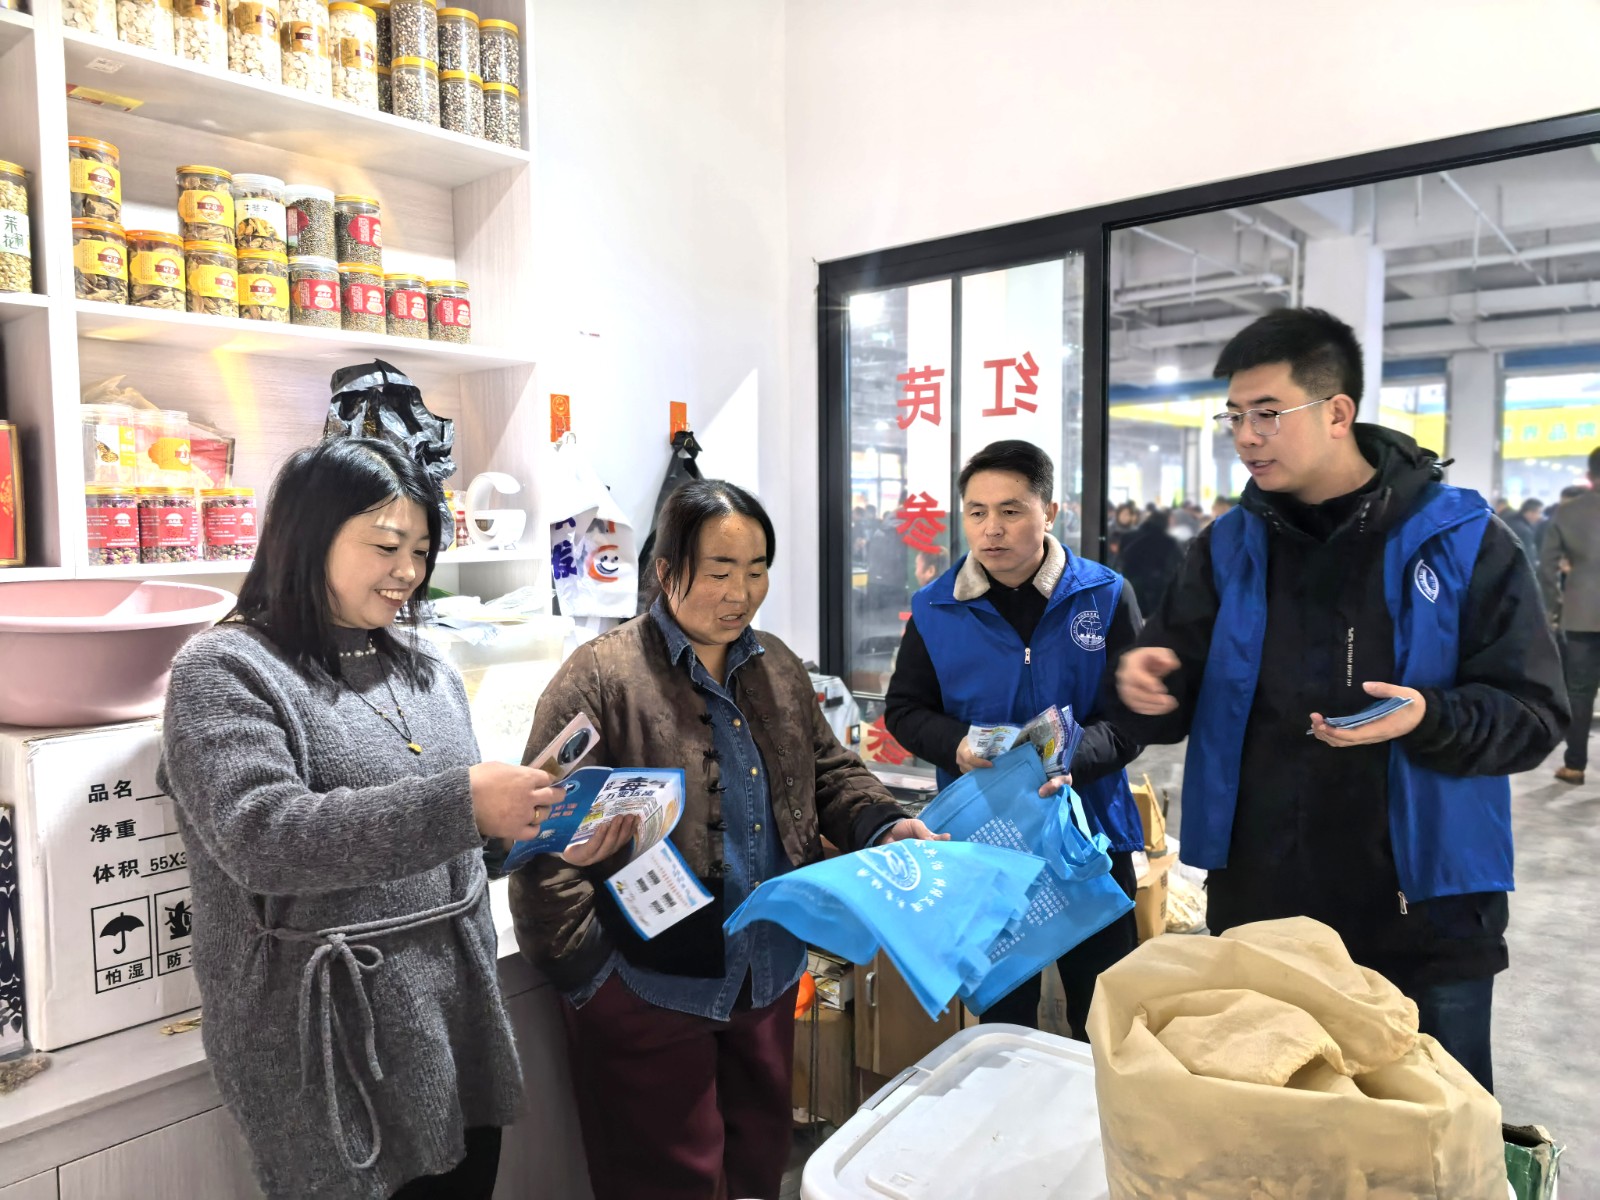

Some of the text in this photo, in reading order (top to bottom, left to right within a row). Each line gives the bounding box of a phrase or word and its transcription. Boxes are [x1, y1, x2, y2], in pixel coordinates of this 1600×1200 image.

[88, 779, 133, 803] 品名
[90, 819, 137, 843] 净重
[92, 858, 140, 885] 体积
[167, 951, 193, 969] 防
[105, 963, 145, 986] 怕湿
